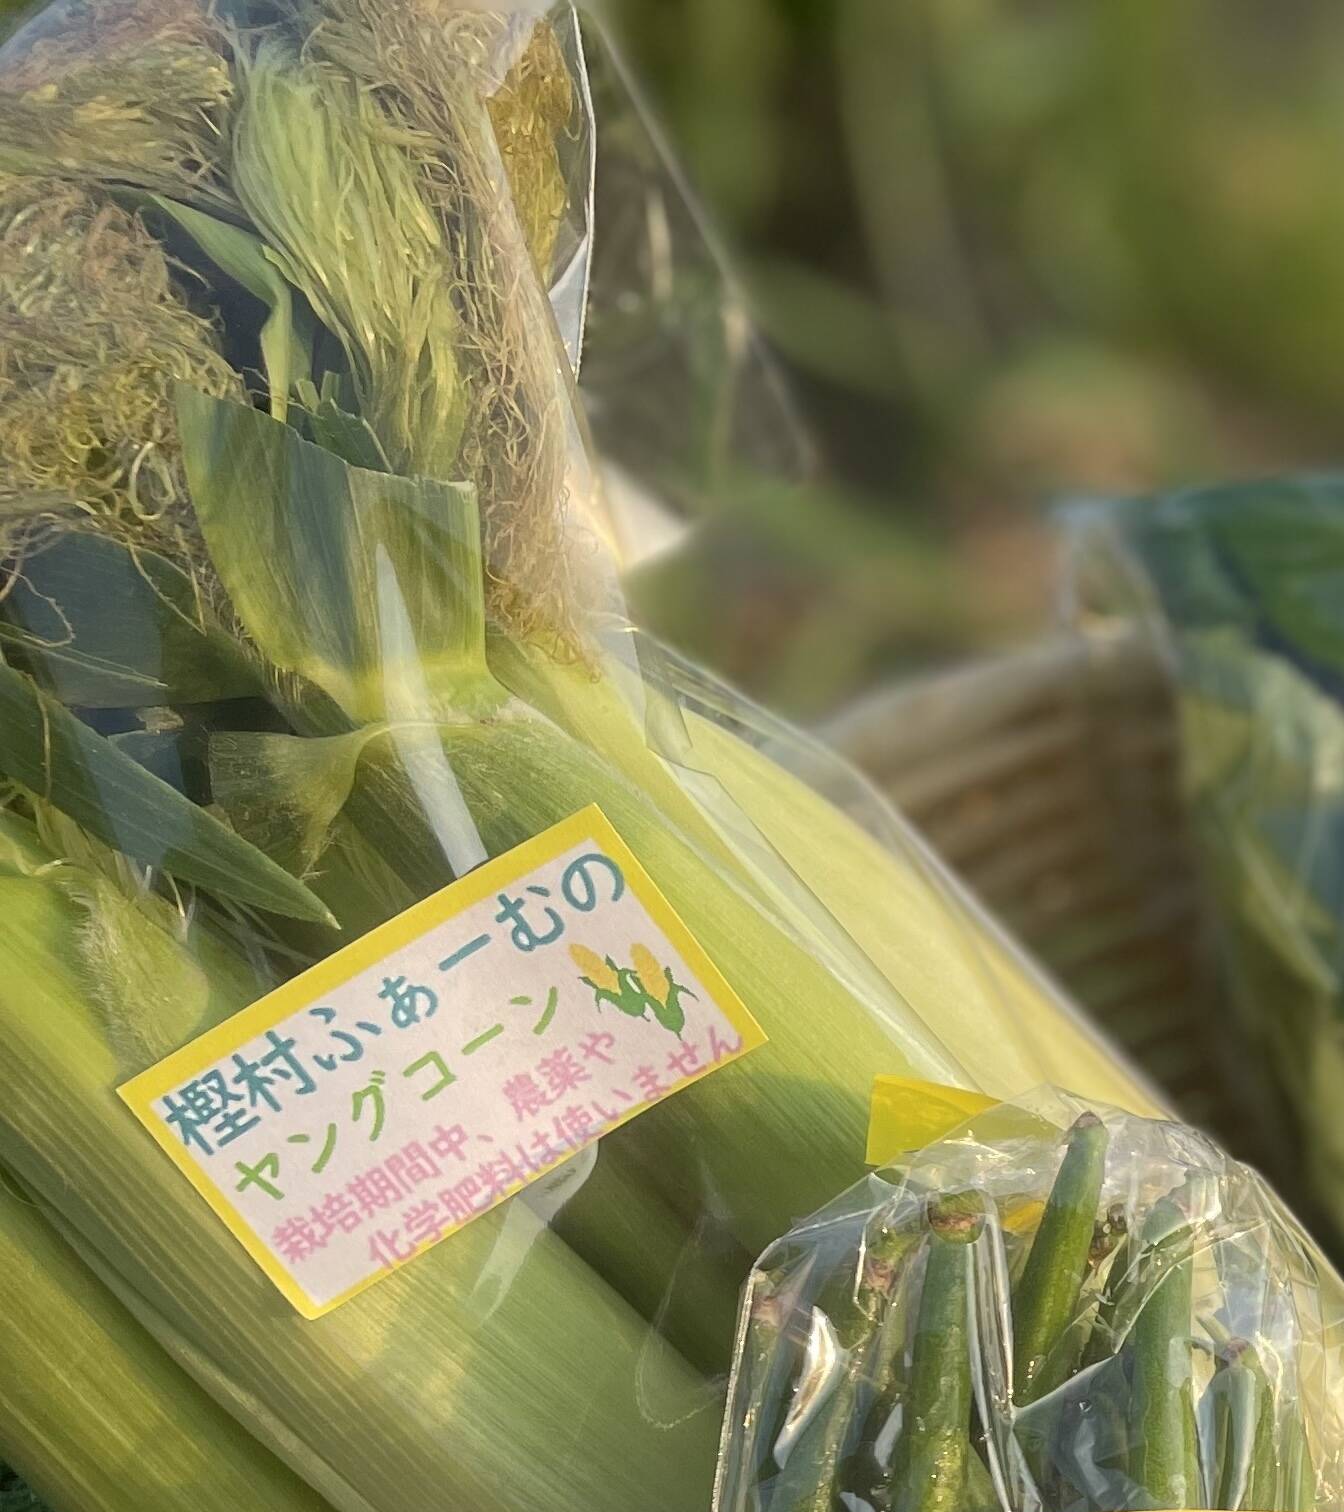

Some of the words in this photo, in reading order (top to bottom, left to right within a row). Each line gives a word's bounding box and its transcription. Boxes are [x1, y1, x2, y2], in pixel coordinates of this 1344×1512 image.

[163, 851, 625, 1156] 樫村ふぁーむの
[234, 987, 558, 1200] ヤングコーン
[366, 1026, 742, 1270] 化学肥料は使いません
